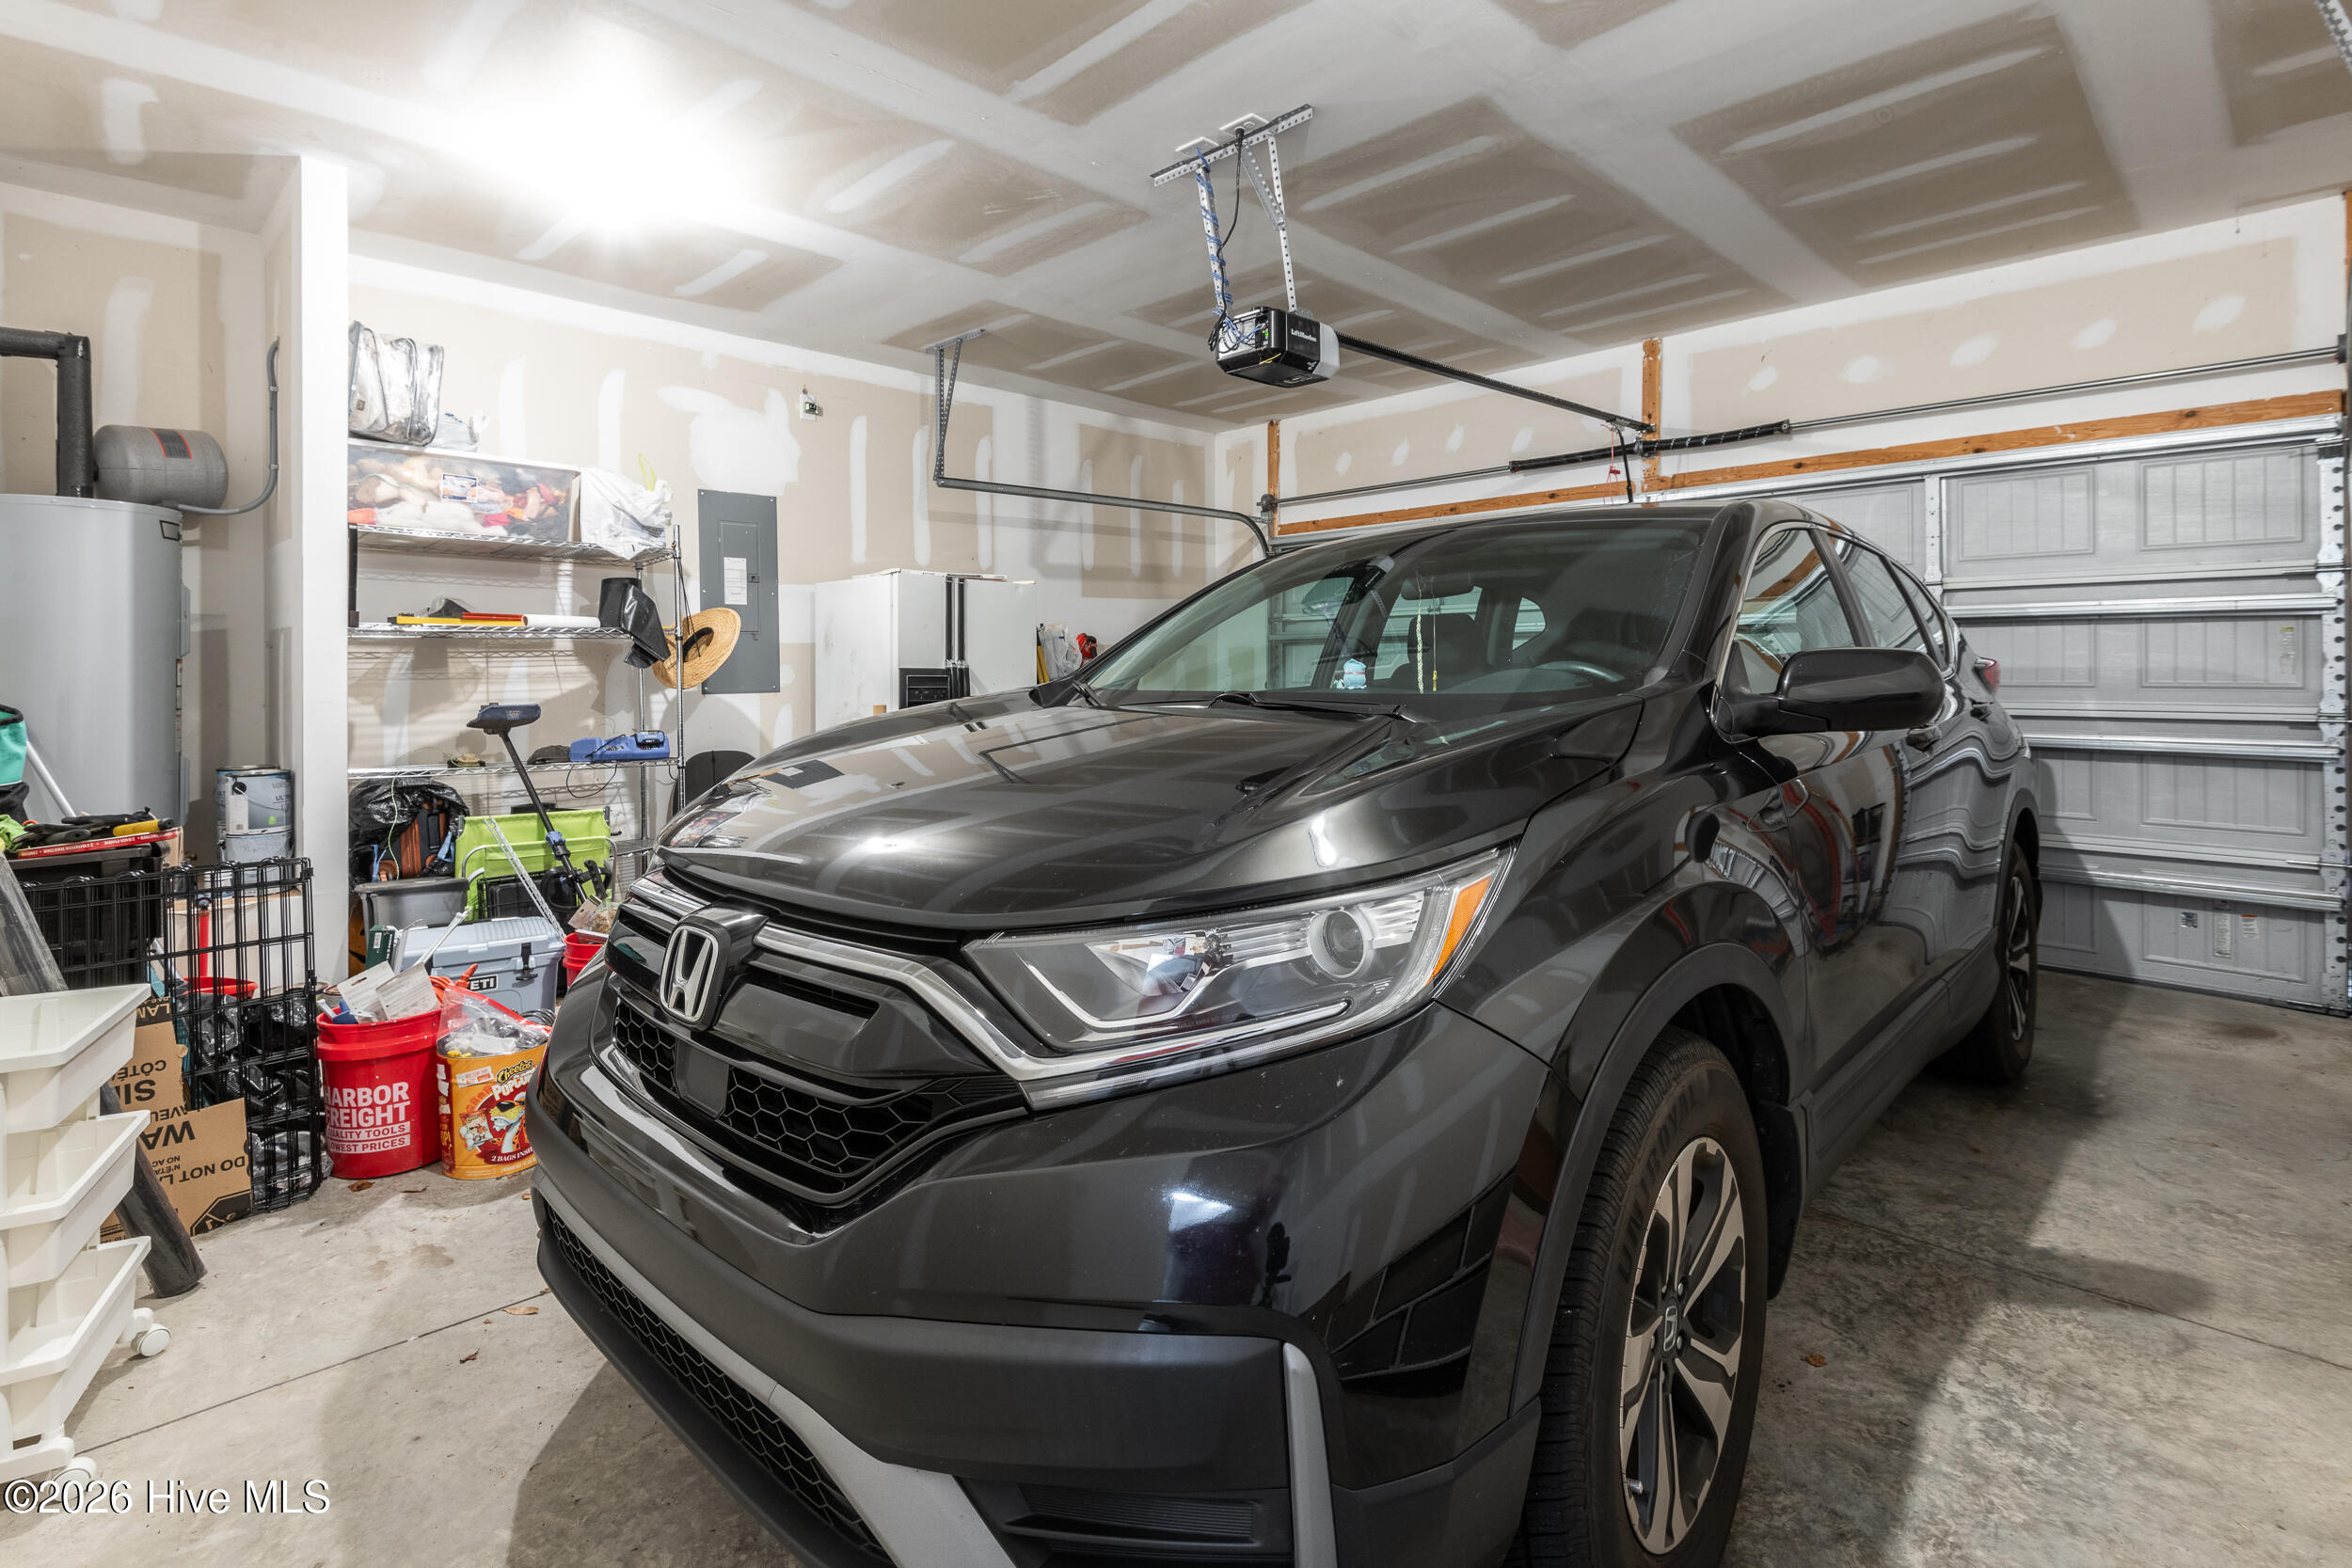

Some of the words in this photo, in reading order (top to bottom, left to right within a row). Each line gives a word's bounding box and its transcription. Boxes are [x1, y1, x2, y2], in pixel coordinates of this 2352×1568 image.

[469, 978, 495, 990] ETI
[497, 1060, 533, 1084] Cheetos
[325, 1082, 409, 1107] HARBOR
[325, 1101, 410, 1128] FREIGHT
[327, 1126, 362, 1140] QUALITY
[365, 1124, 405, 1138] TOOLS
[328, 1141, 359, 1152] LOWEST
[362, 1137, 405, 1151] PRICES
[167, 1155, 180, 1164] NO
[220, 1156, 246, 1172] DO
[497, 1153, 516, 1162] BAGS
[179, 1163, 215, 1182] NOT
